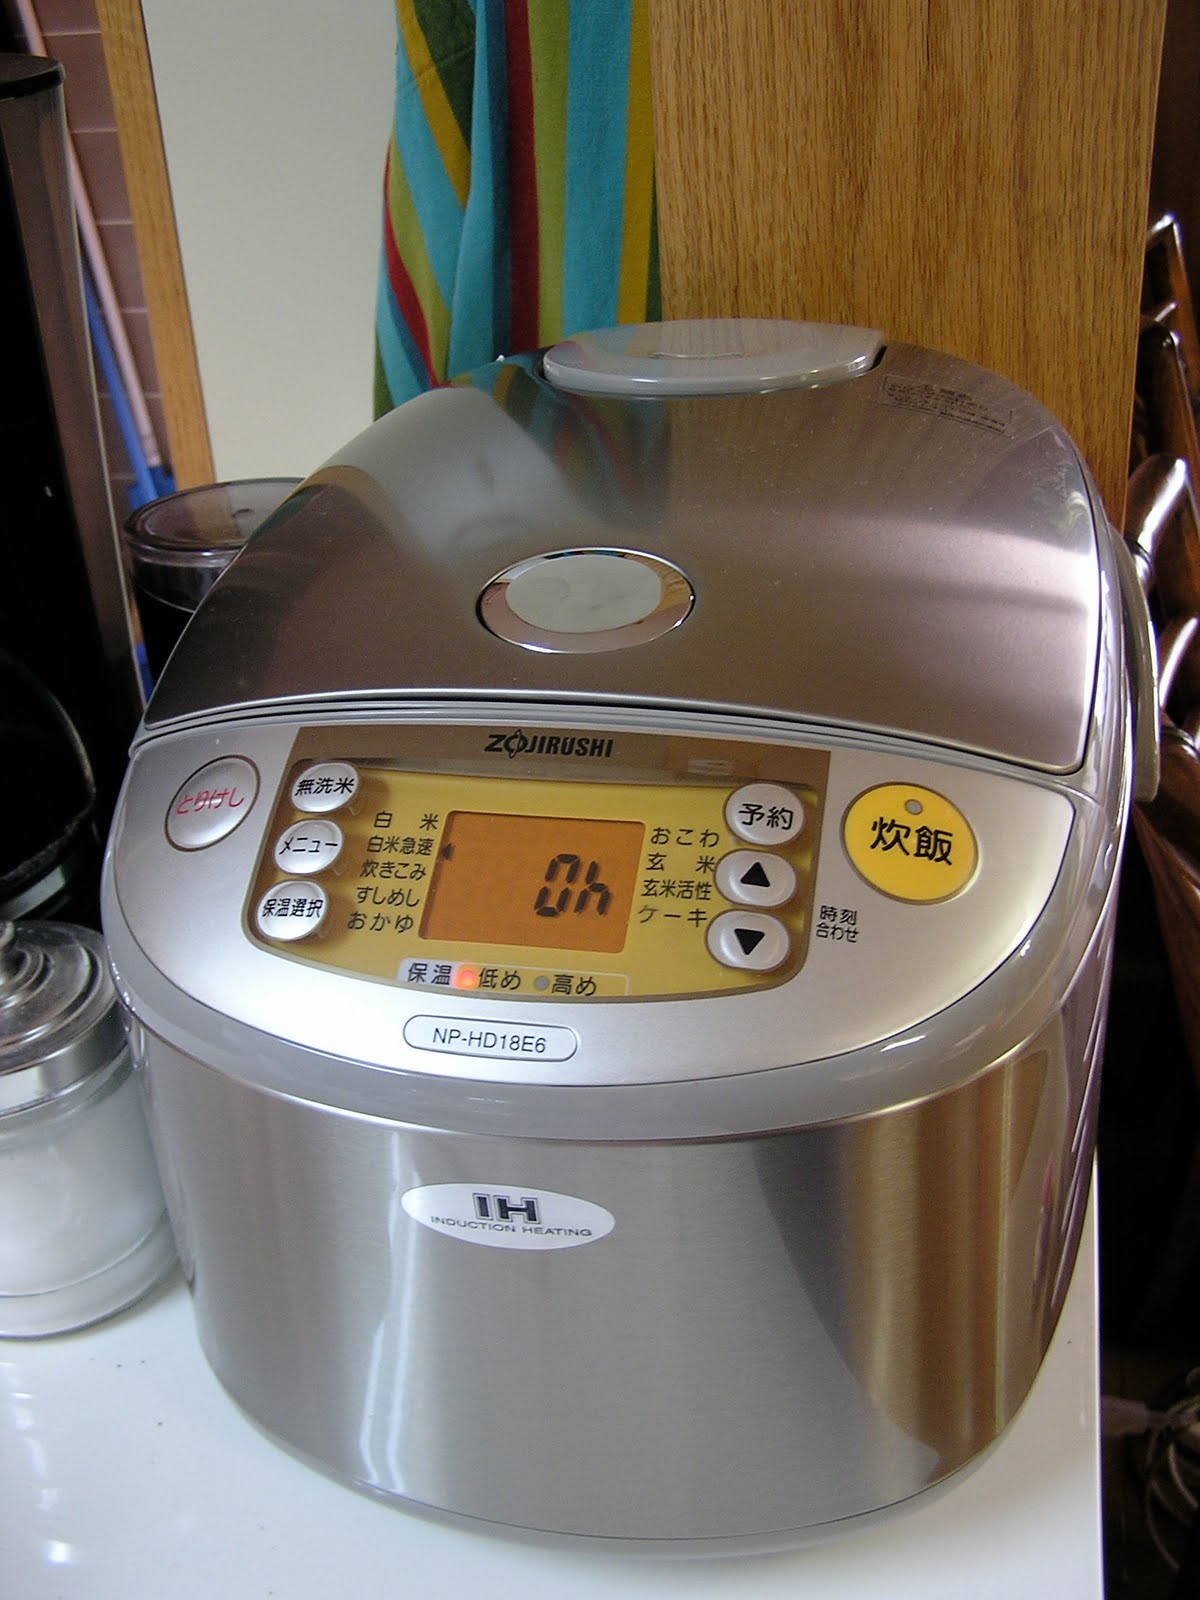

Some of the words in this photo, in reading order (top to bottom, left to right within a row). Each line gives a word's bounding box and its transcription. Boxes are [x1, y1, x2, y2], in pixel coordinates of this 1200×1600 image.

[484, 729, 614, 758] ZOJIRUSHI
[294, 777, 355, 797] 無洗米
[176, 787, 245, 816] とりけし
[738, 803, 794, 831] 予約
[278, 837, 339, 856] メニュー
[366, 836, 433, 856] 白米急速
[650, 826, 720, 848] おこわ
[870, 816, 953, 866] 炊飯
[360, 859, 427, 881] 炊きこみ
[356, 886, 420, 906] すしめし
[640, 878, 712, 902] 玄米活性
[262, 898, 323, 918] 保温選択
[637, 905, 708, 928] ケーキ
[820, 904, 858, 925] 時刻
[347, 912, 414, 934] おかゆ
[816, 923, 860, 943] 合わせ
[407, 962, 452, 986] 保温
[478, 968, 521, 991] 低め
[552, 974, 597, 996] 高め
[432, 1027, 547, 1053] NP-HD18E6
[472, 1192, 541, 1224] IH
[430, 1216, 516, 1233] INDUCTION
[522, 1226, 593, 1237] HEATING
